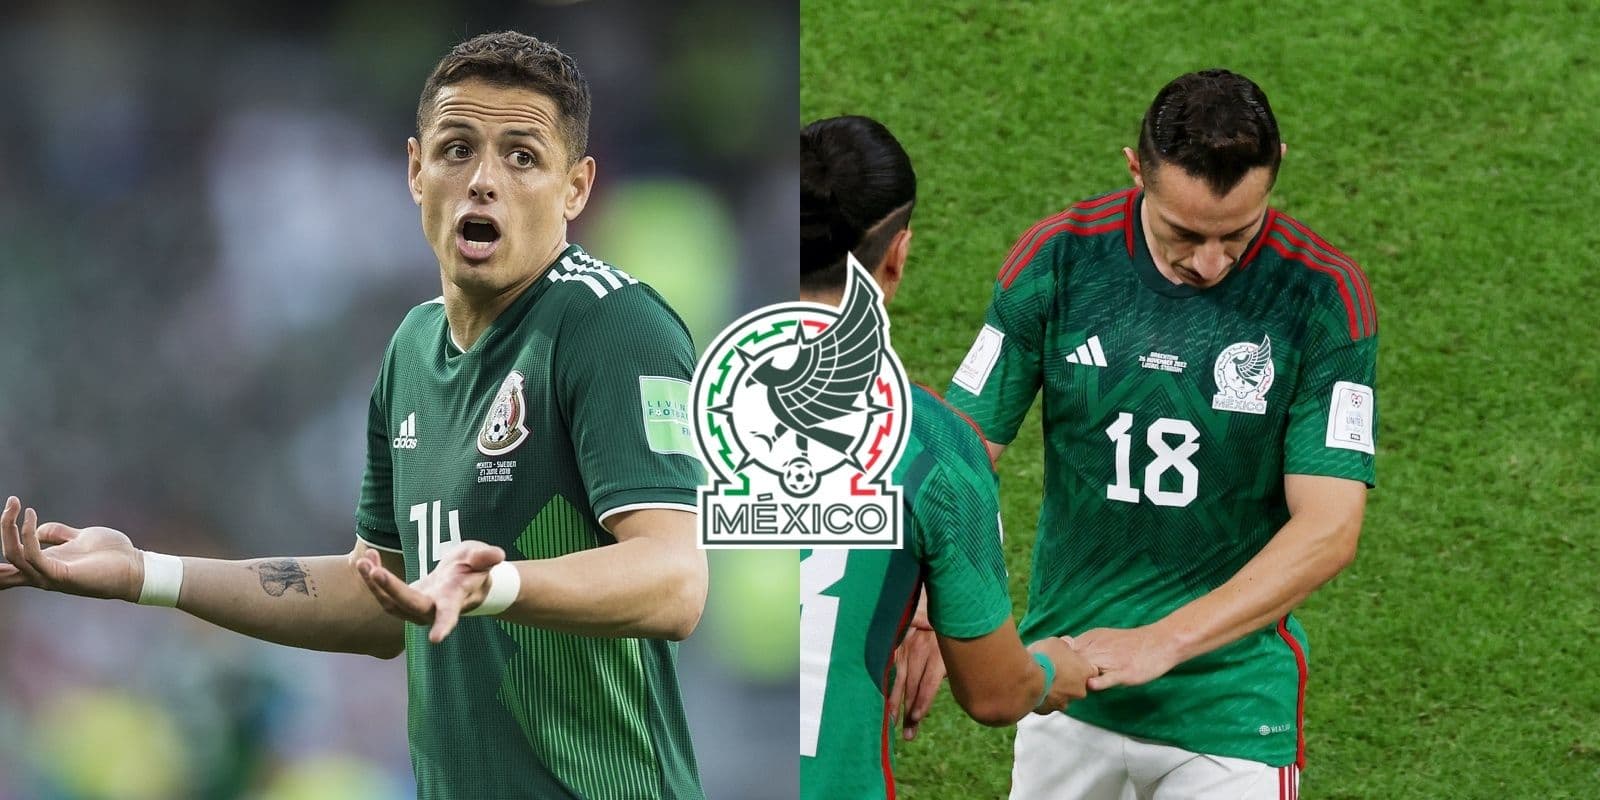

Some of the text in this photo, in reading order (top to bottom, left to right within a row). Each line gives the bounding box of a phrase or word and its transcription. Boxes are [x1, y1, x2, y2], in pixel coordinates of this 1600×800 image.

[648, 400, 686, 411] LIVIN
[392, 434, 418, 449] adidas
[1105, 412, 1200, 507] 18
[409, 499, 462, 582] 14
